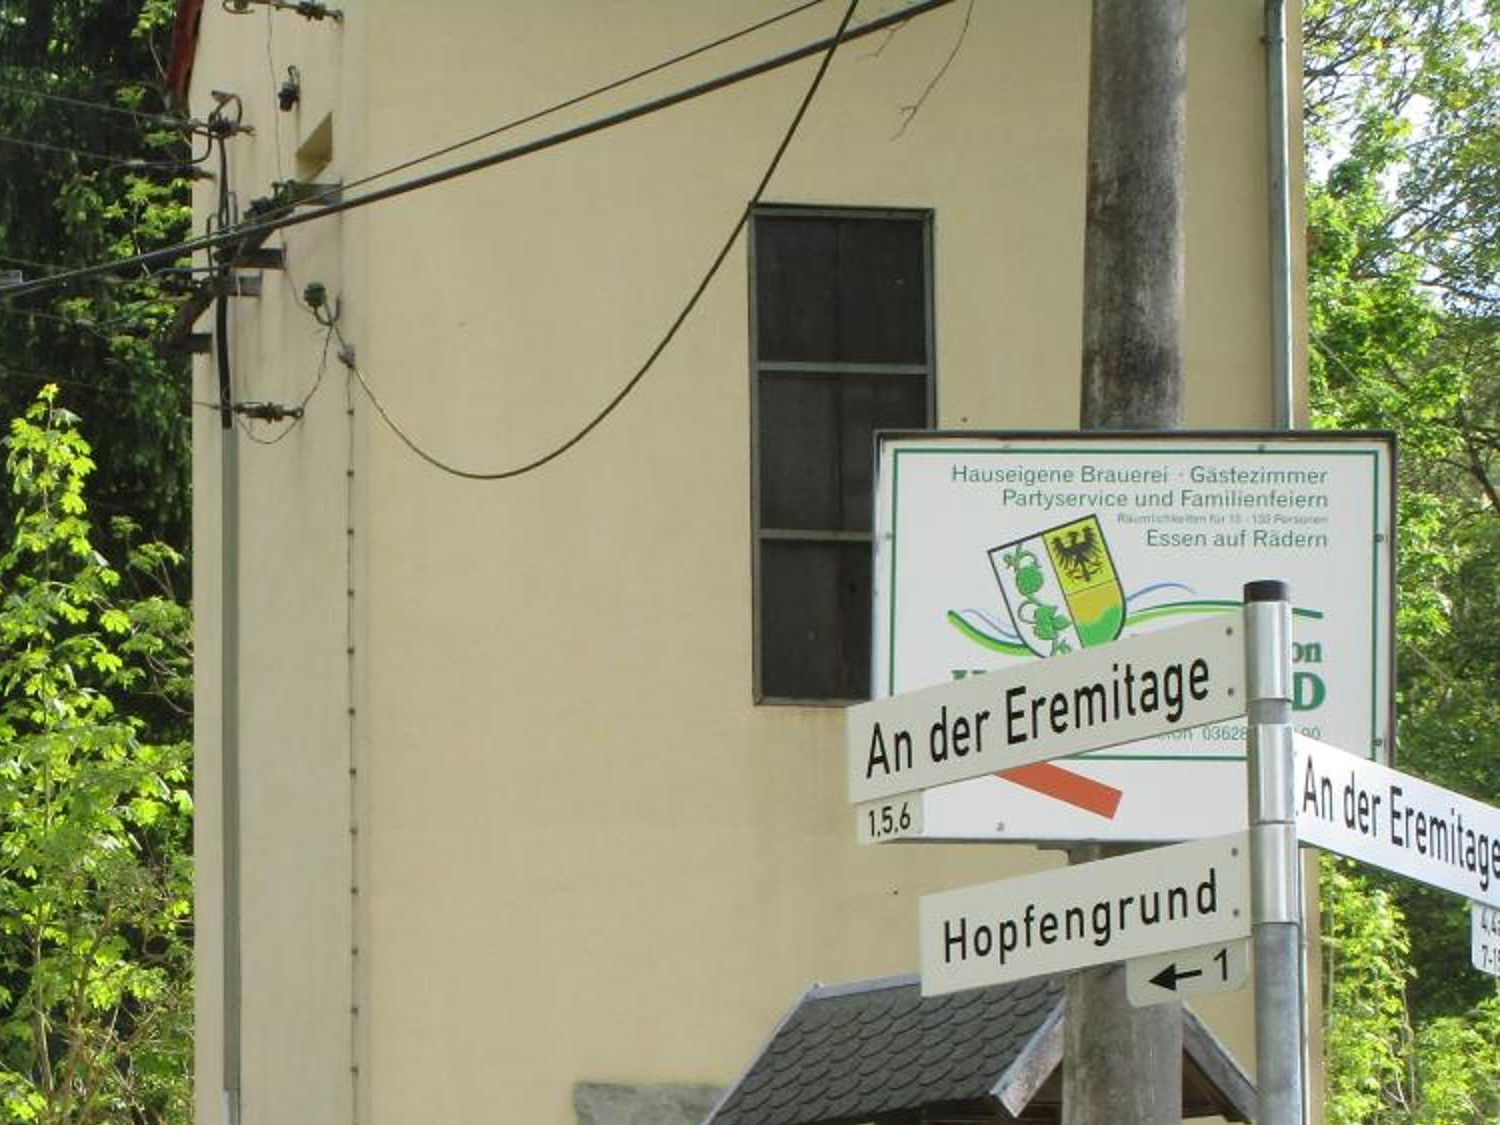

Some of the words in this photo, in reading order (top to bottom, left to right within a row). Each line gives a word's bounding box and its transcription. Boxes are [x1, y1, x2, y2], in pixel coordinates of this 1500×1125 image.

[951, 465, 1075, 487] Hauseigene
[1081, 465, 1169, 484] Brauerei
[1190, 465, 1329, 484] Gästezimmer
[1002, 489, 1129, 511] Partyservice
[1134, 489, 1174, 508] und
[1180, 489, 1329, 508] Familienfeiern
[1146, 529, 1207, 547] Essen
[1213, 528, 1246, 547] auf
[1252, 527, 1329, 547] Rädern
[866, 721, 913, 779] An
[929, 705, 991, 763] der
[1005, 656, 1209, 745] Eremitage
[1302, 754, 1333, 822] An
[1343, 769, 1382, 838] der
[1389, 785, 1500, 892] Eremitage
[943, 867, 1218, 965] Hopfengrund
[1212, 948, 1229, 982] 1
